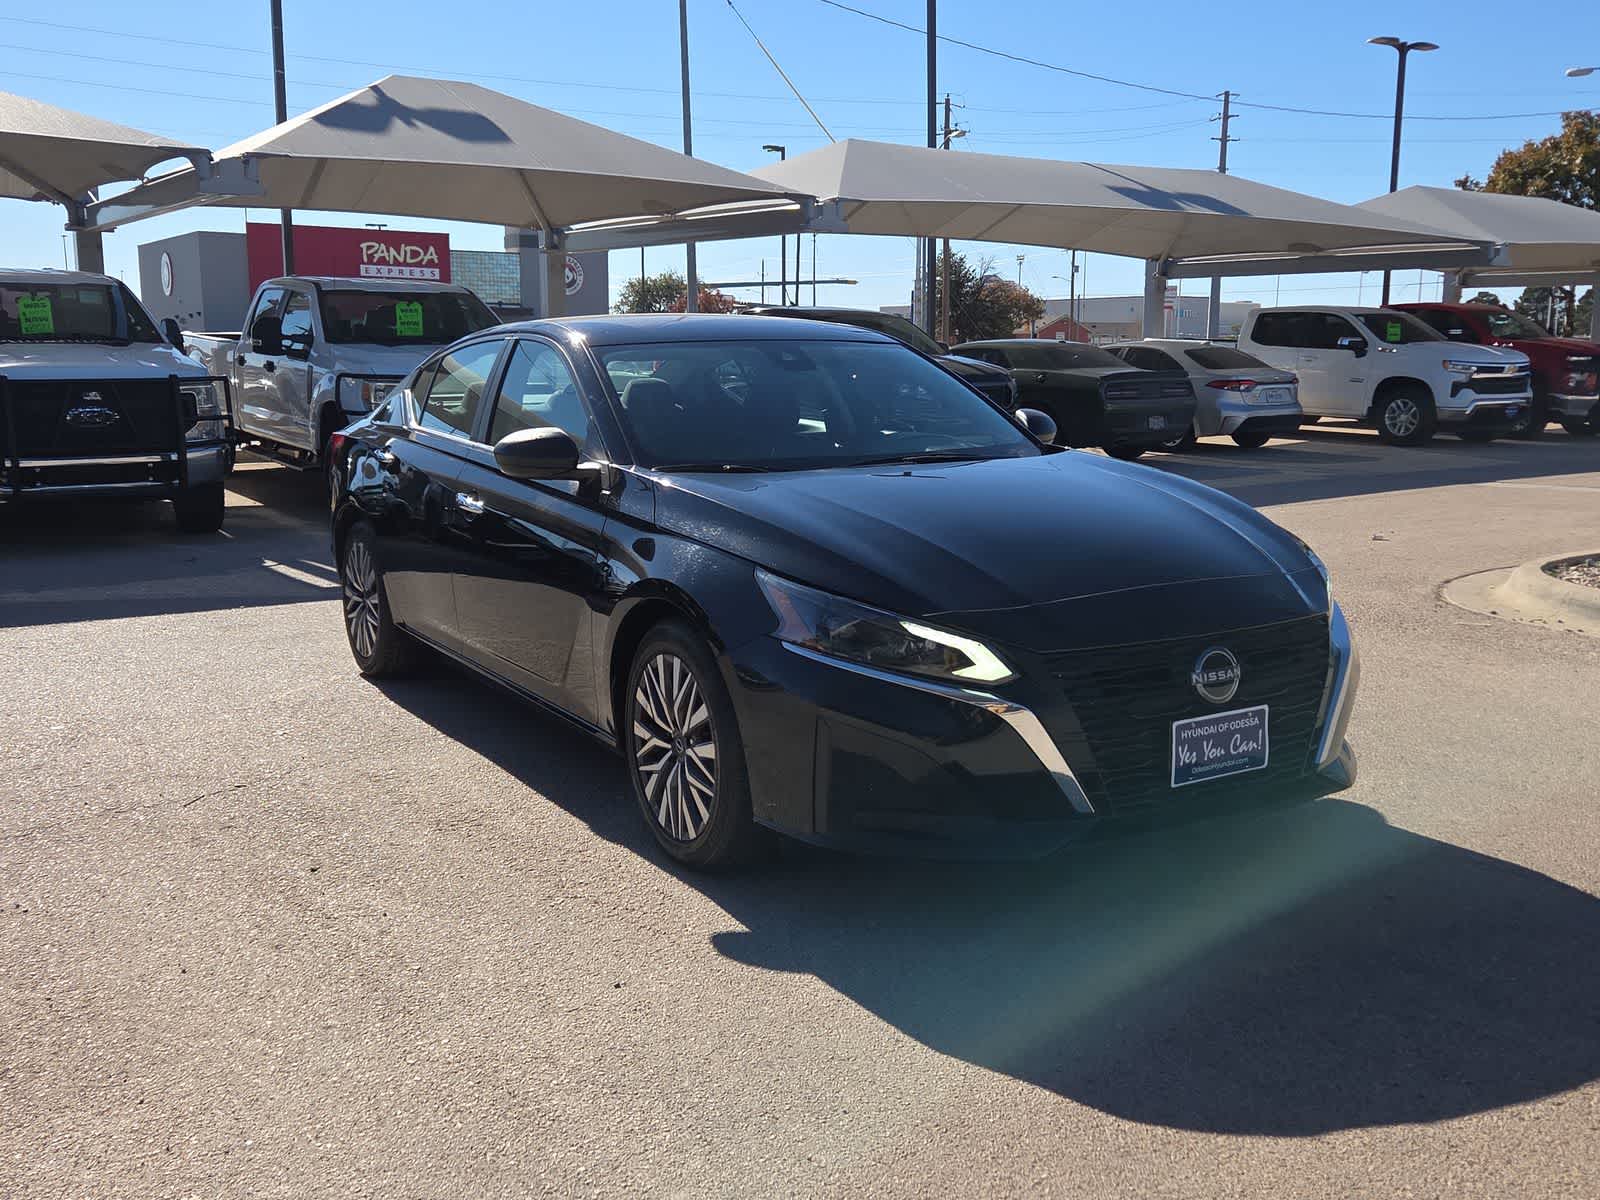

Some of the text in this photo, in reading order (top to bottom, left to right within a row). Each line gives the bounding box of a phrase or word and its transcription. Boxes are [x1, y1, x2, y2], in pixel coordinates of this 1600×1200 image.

[359, 241, 440, 265] PANDA
[364, 266, 437, 278] EXPRESS
[1192, 664, 1241, 686] NISSAN
[1181, 716, 1260, 740] HYUNDAI OF ODESSA
[1178, 728, 1263, 767] Yes You Can!
